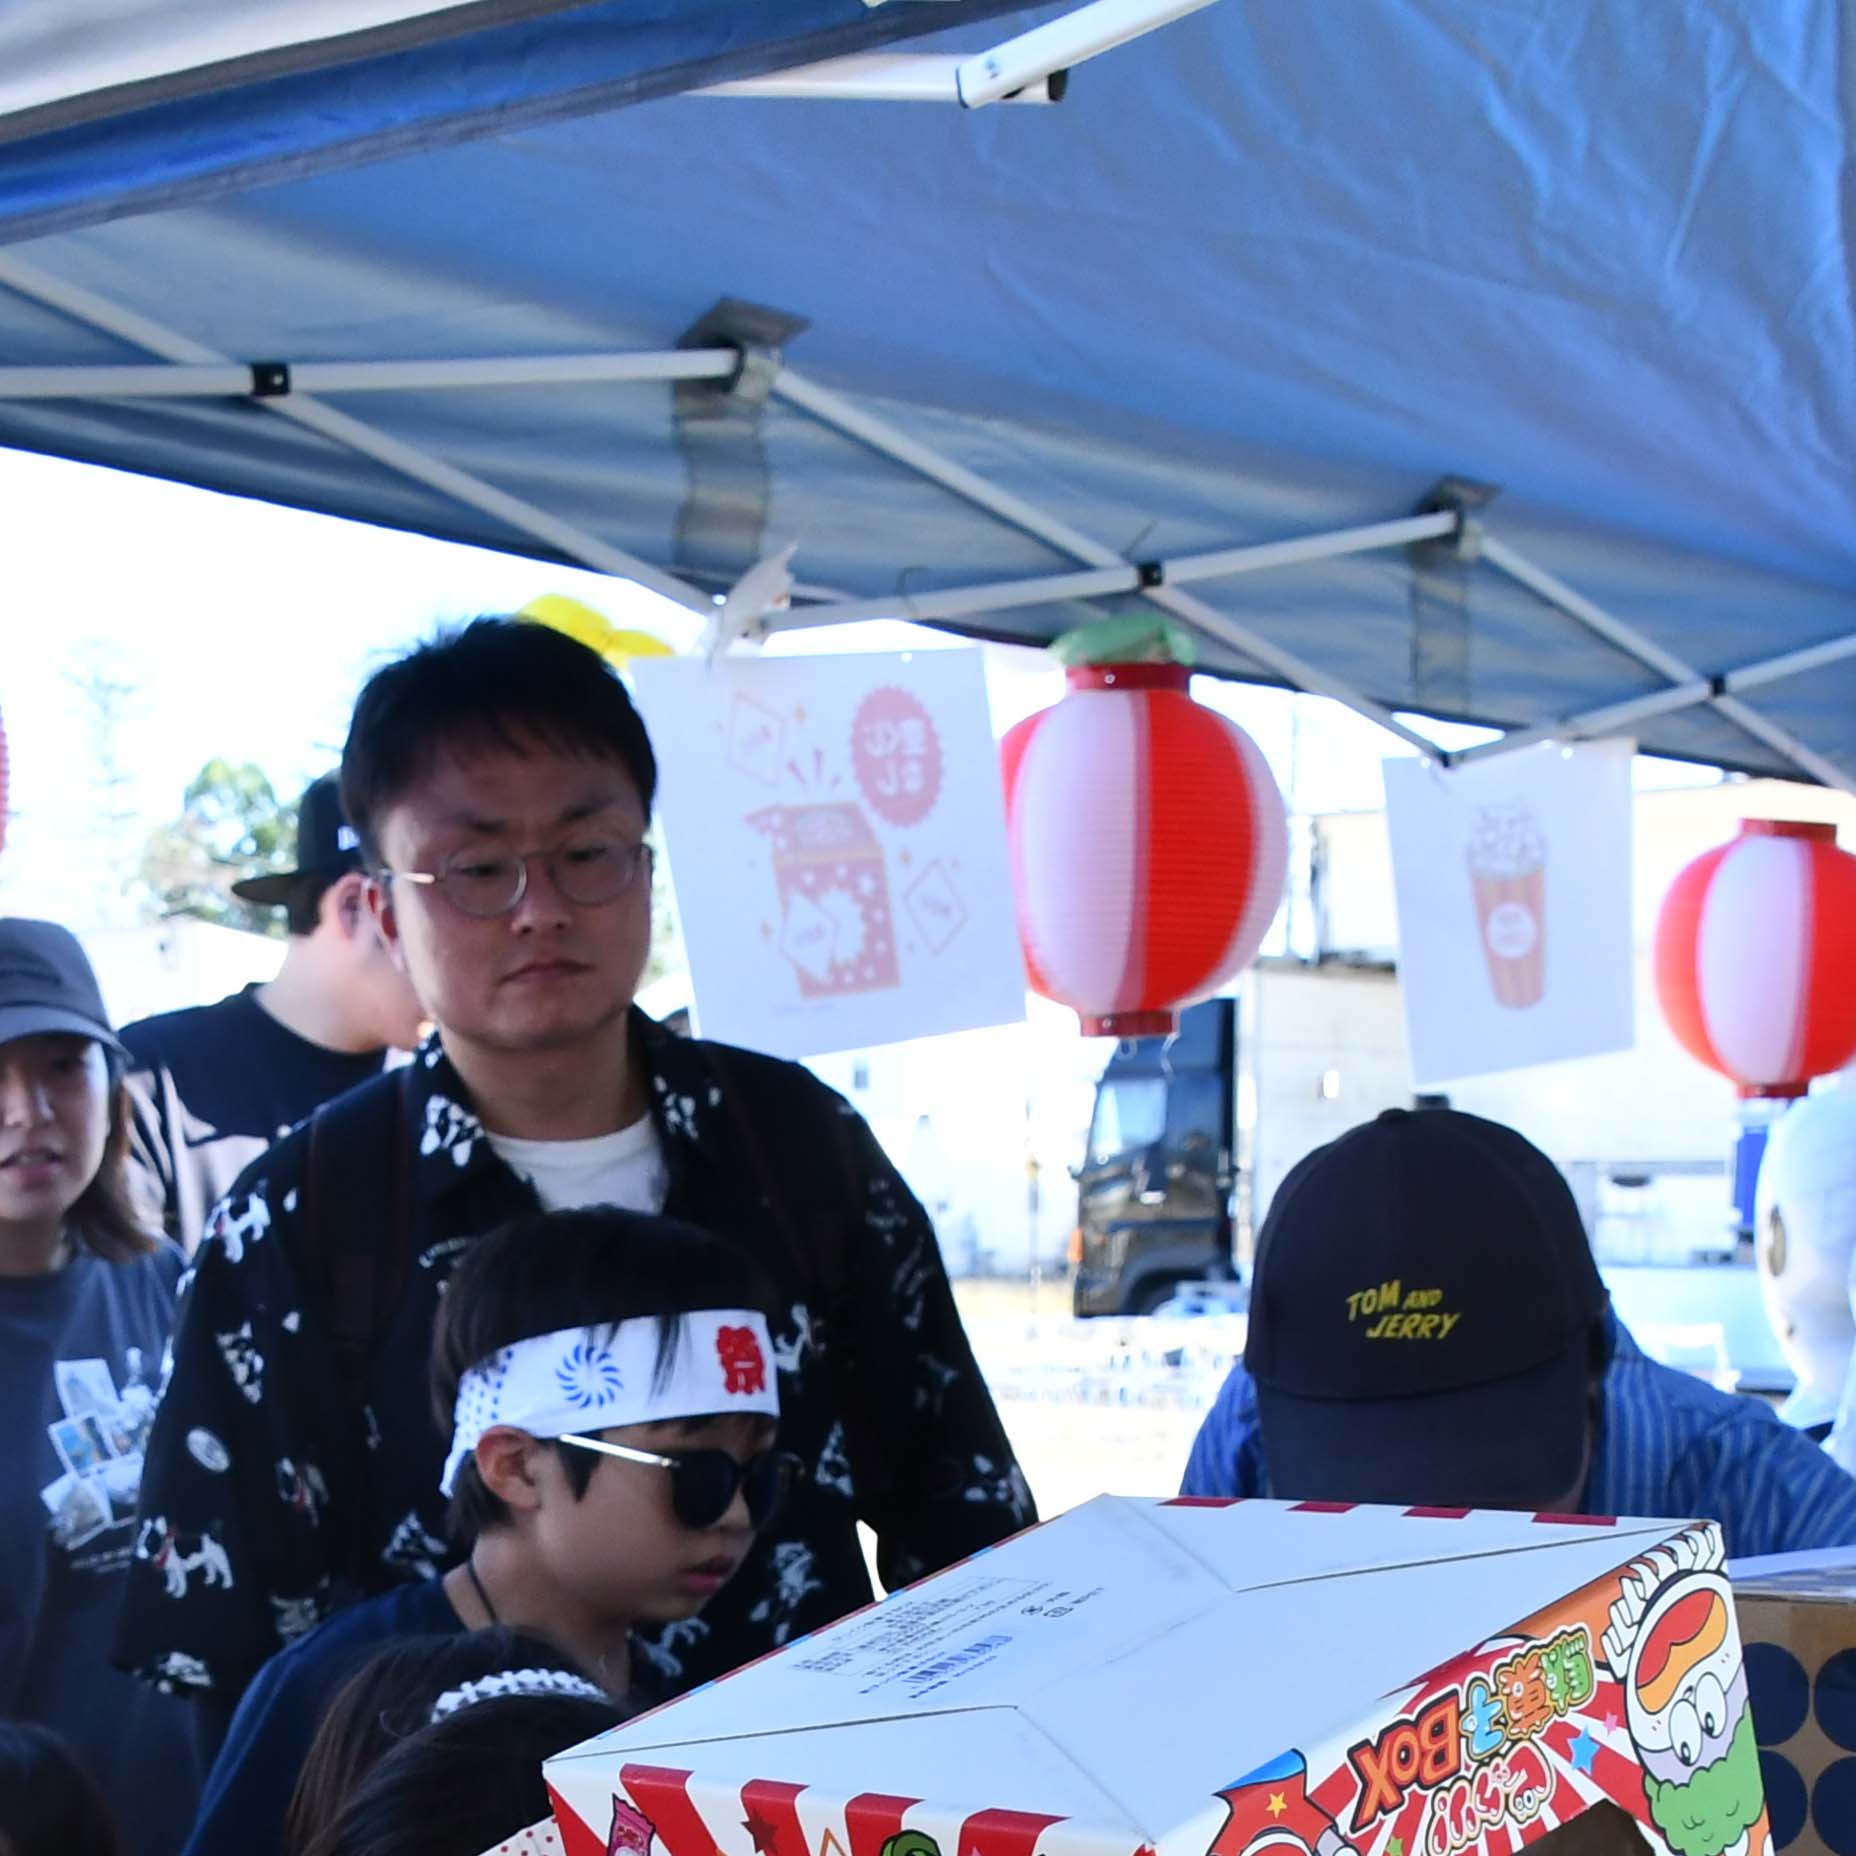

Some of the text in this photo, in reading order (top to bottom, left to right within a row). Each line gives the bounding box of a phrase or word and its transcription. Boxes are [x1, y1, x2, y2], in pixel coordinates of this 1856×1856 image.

[1345, 1279, 1443, 1322] TOM AND
[1365, 1312, 1461, 1339] JERRY
[1462, 1628, 1594, 1760] 駄菓子
